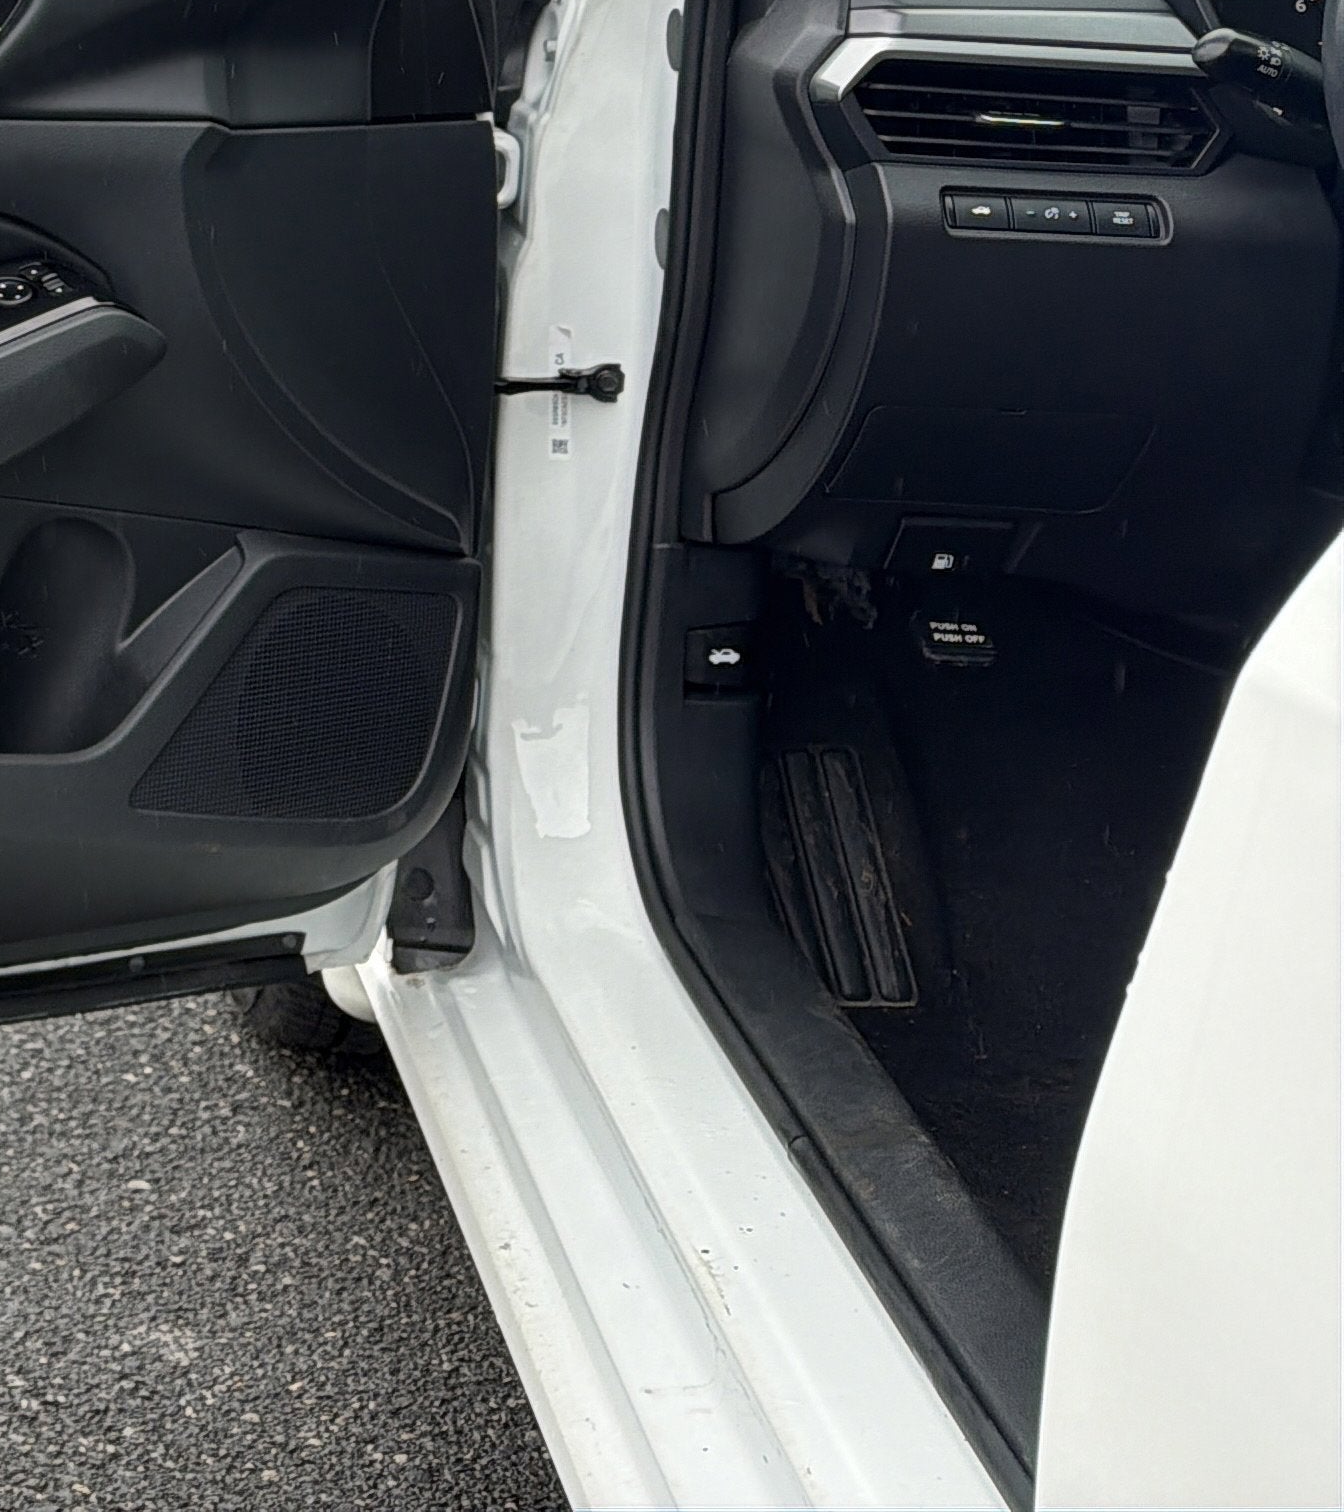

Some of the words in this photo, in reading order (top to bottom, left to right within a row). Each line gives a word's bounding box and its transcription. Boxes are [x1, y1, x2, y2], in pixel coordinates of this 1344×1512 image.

[1256, 64, 1279, 78] AUTO
[929, 621, 959, 630] PUSH
[933, 632, 962, 643] PUSH
[965, 634, 985, 644] OFF
